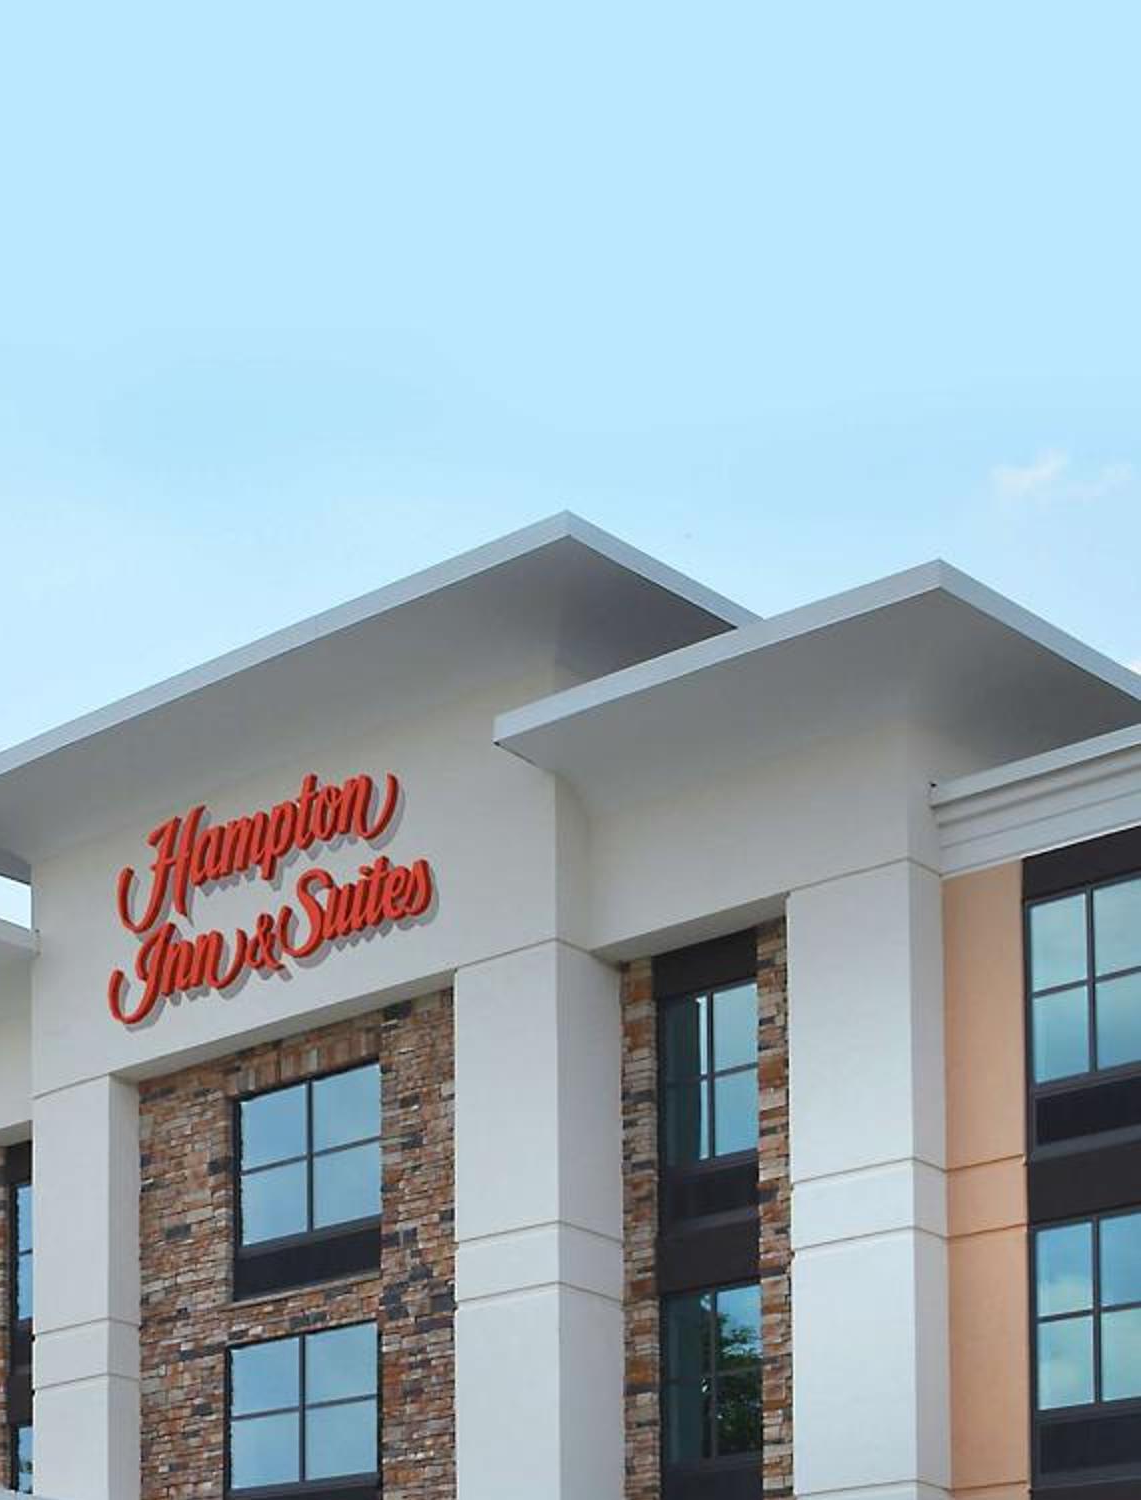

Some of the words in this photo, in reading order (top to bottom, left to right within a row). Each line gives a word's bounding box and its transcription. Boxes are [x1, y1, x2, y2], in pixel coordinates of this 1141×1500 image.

[117, 772, 399, 934] Hampton
[108, 922, 248, 1025] Inn
[245, 913, 286, 971] &
[277, 855, 434, 959] Suites
